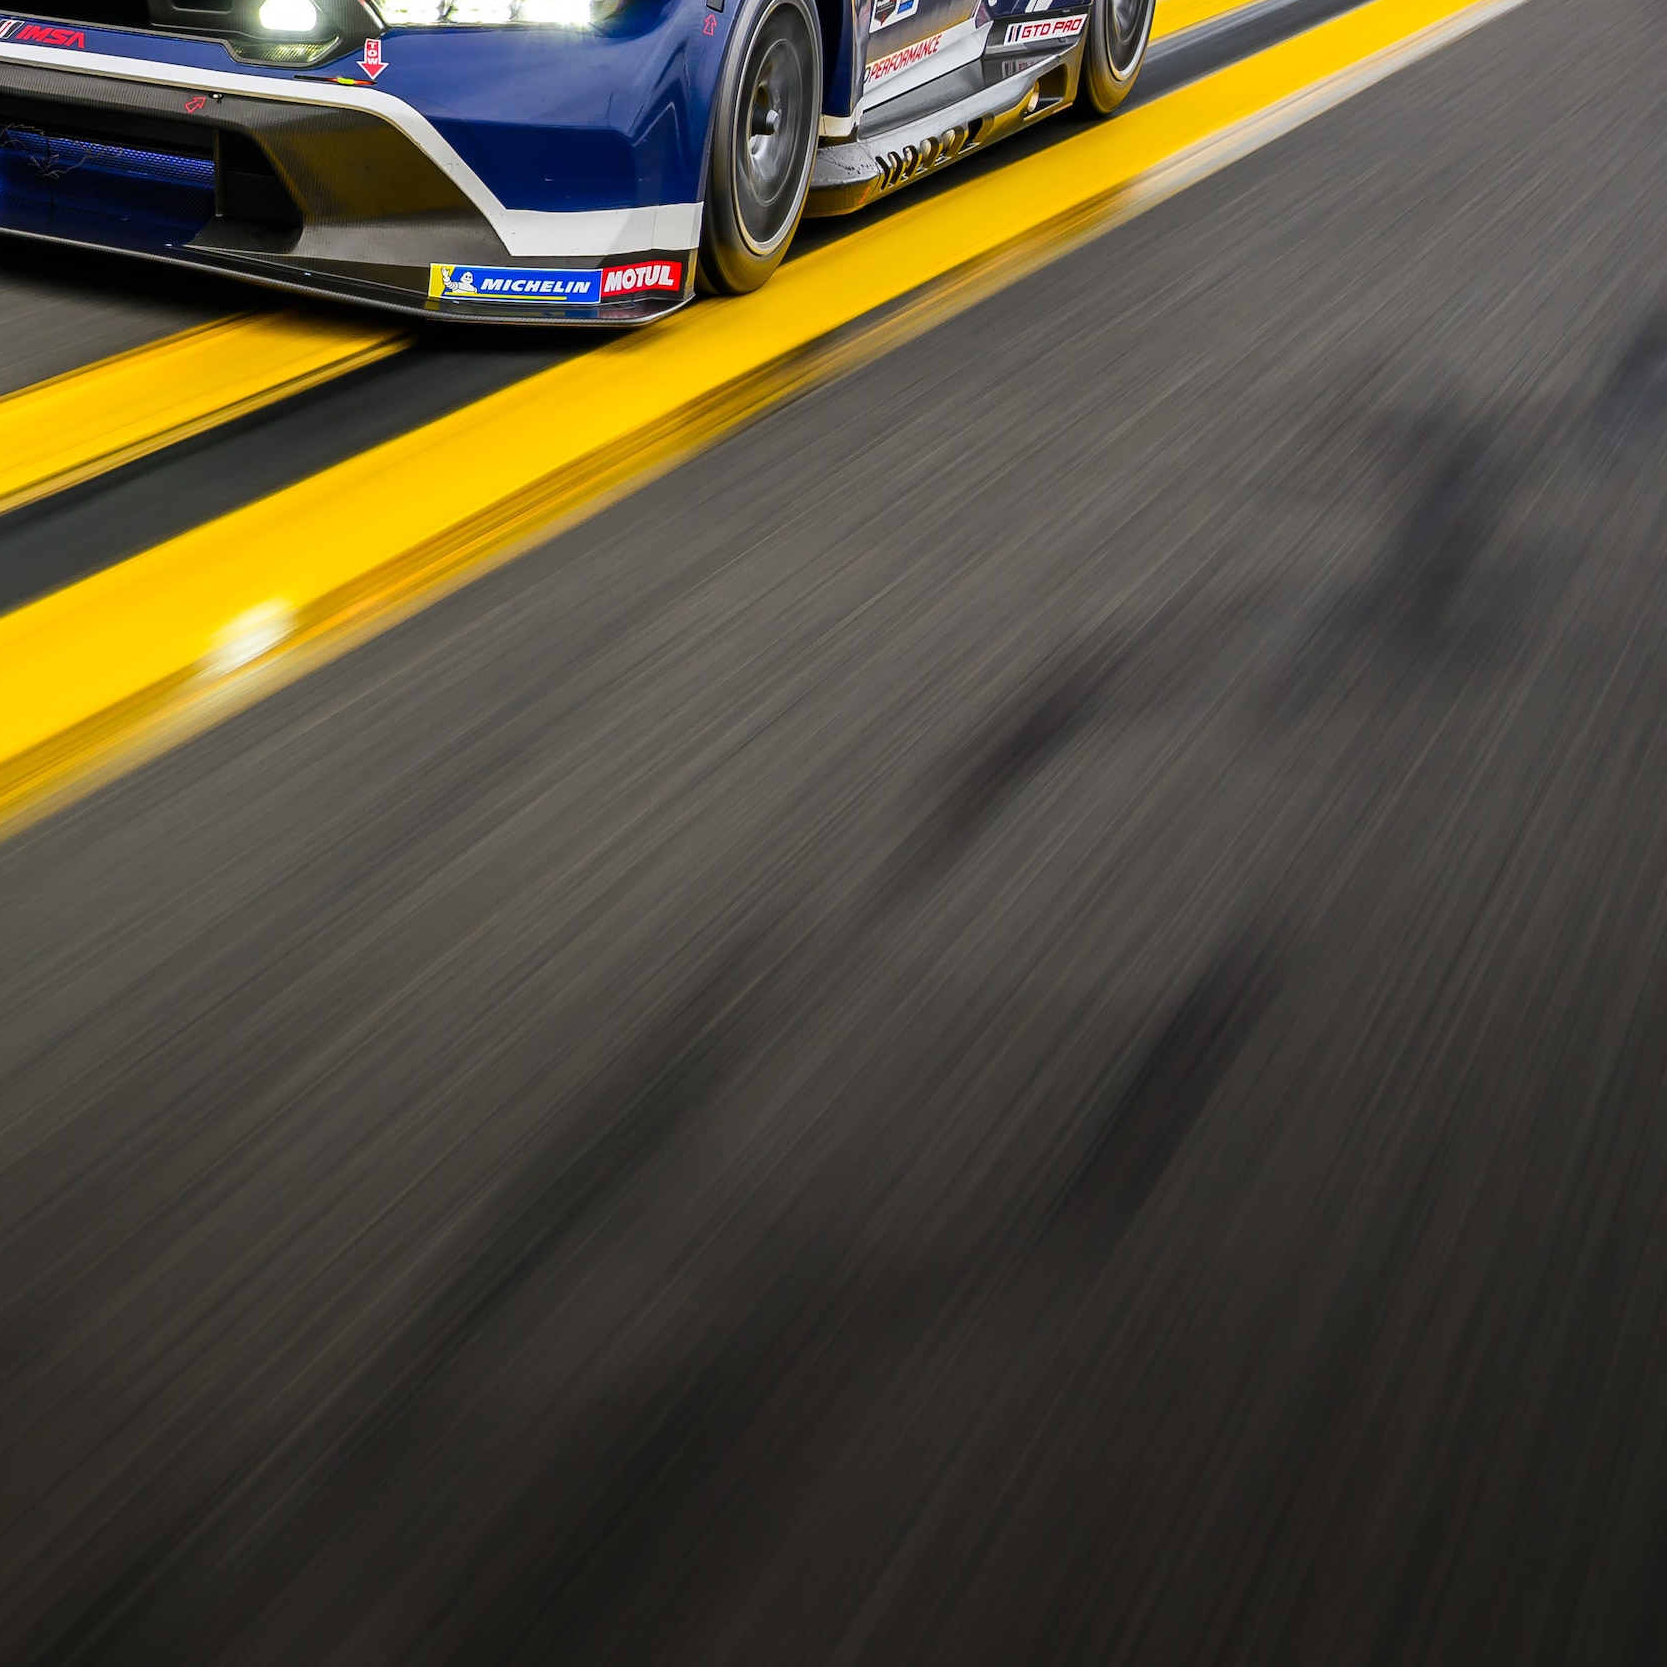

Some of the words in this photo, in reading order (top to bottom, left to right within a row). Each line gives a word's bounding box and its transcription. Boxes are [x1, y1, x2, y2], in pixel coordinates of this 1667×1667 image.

[16, 24, 85, 49] IMSA
[1021, 23, 1051, 39] GTD
[1052, 18, 1083, 34] PRO
[367, 42, 379, 65] TOW
[480, 278, 591, 294] MICHELIN
[604, 265, 675, 292] MOTUL
